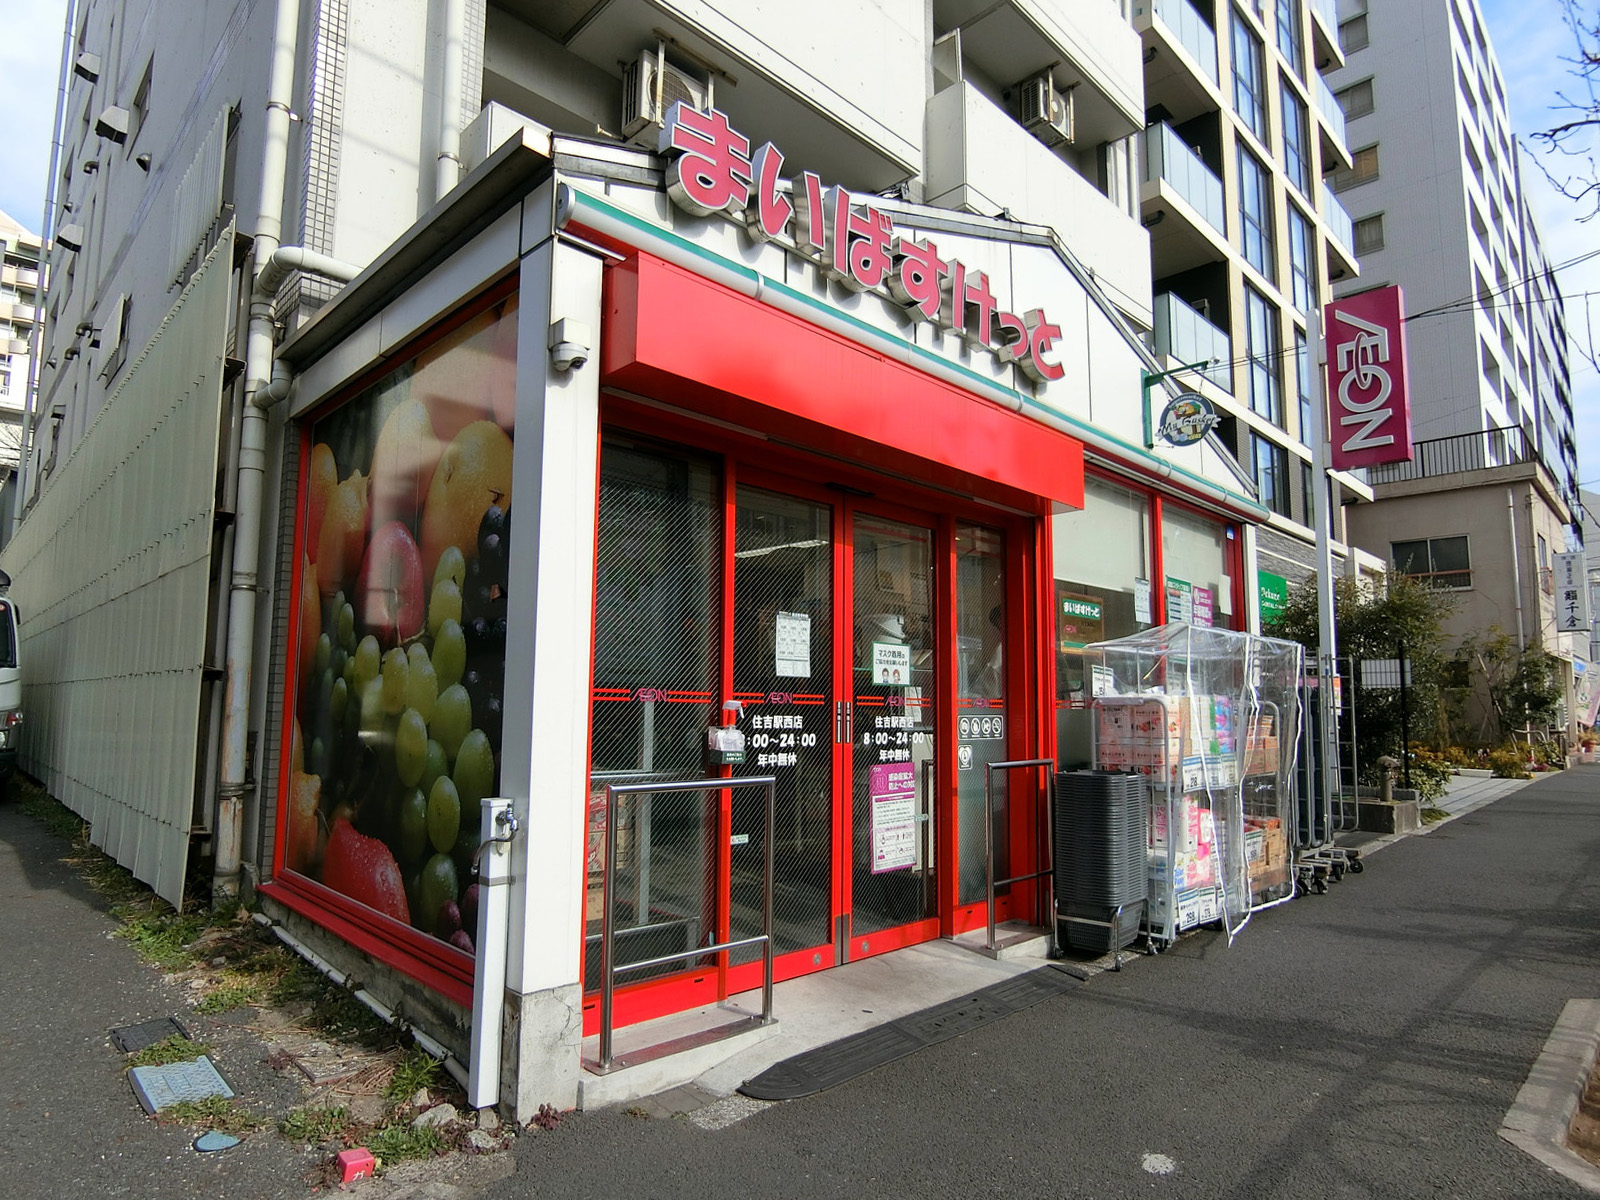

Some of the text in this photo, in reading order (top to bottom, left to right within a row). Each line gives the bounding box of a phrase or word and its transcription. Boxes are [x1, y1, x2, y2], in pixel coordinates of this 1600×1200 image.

[668, 101, 1065, 382] まいばすけっと
[1063, 601, 1100, 618] まいばすけっと
[752, 715, 803, 729] 住吉駅西店
[875, 715, 914, 728] 住吉駅西店
[757, 753, 797, 767] 年中無休
[879, 749, 910, 762] 年中無休
